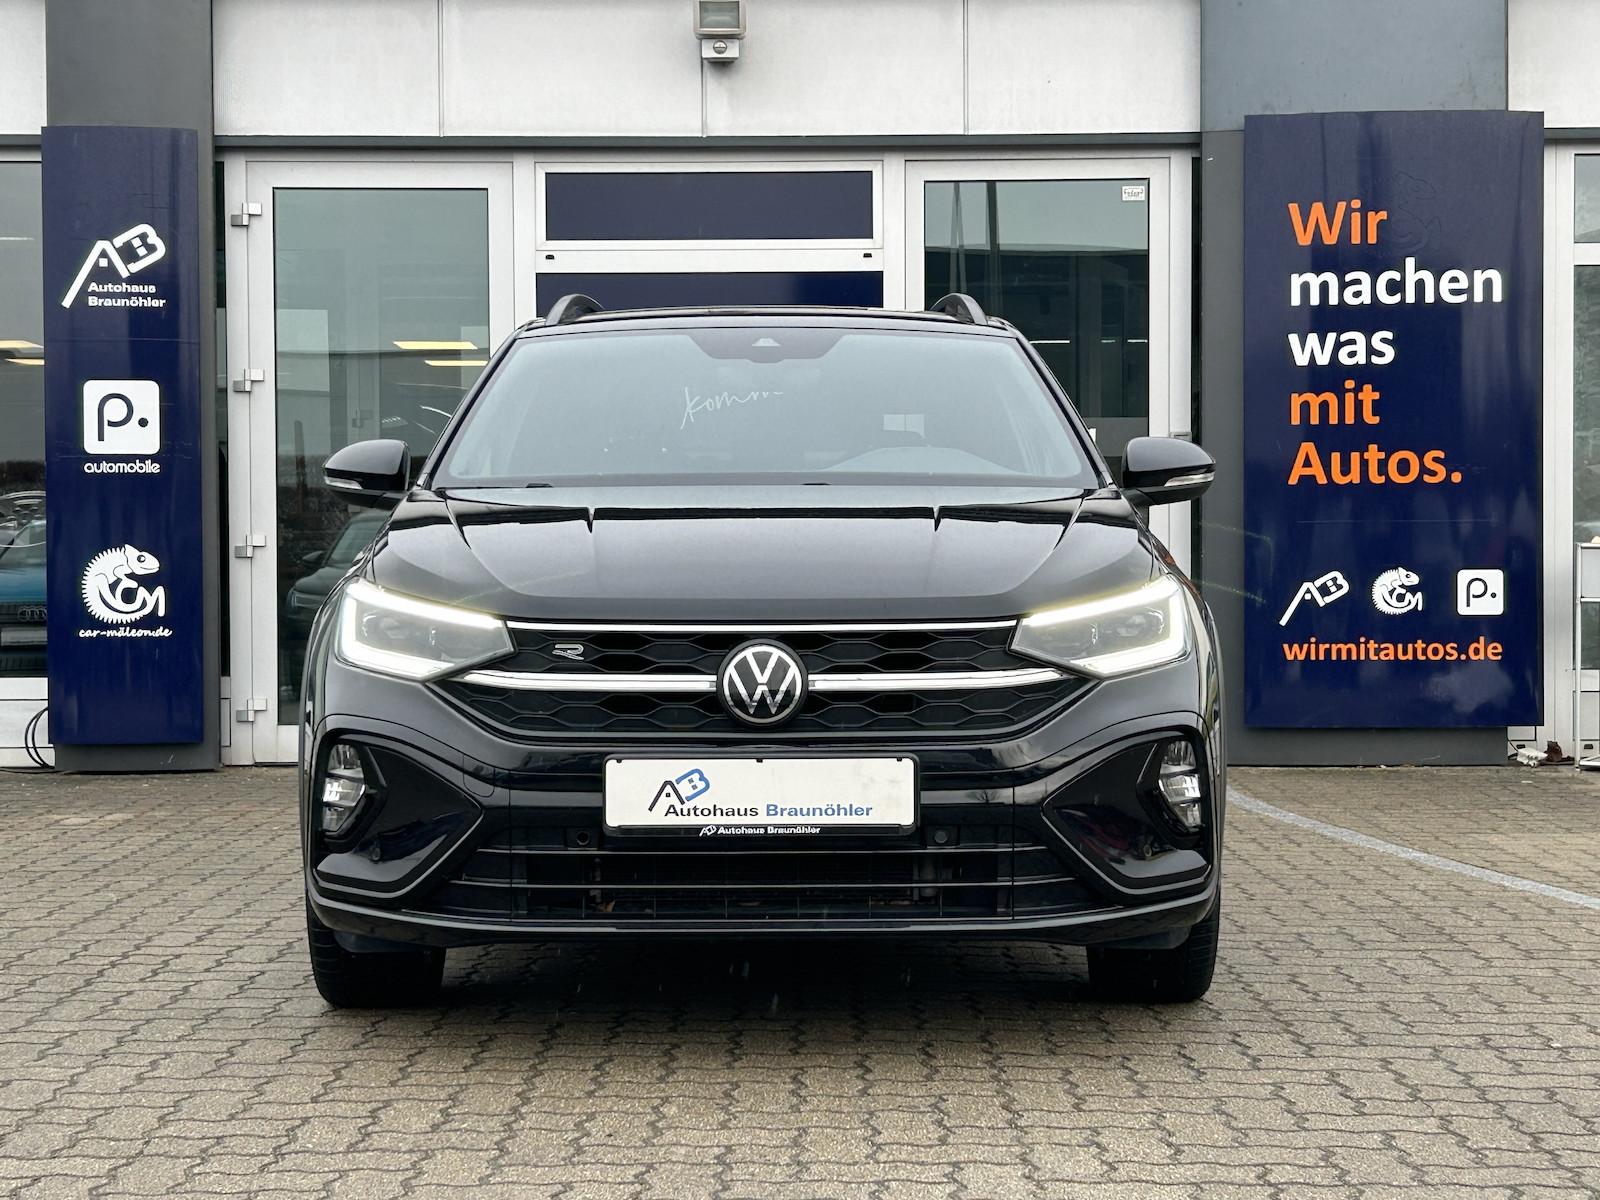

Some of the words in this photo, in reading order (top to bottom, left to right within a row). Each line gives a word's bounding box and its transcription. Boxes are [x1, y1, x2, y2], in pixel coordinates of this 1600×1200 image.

[1288, 199, 1388, 246] Wir
[87, 282, 156, 293] Autohaus
[1290, 256, 1503, 306] machen
[88, 296, 166, 307] Braunöhler
[1288, 330, 1396, 366] was
[1290, 379, 1380, 425] mit
[83, 459, 161, 474] automobile
[1287, 441, 1463, 485] Autos.
[1282, 636, 1503, 661] wirmitautos.de
[664, 804, 759, 817] Autohaus
[766, 803, 873, 817] Braunöhler
[717, 826, 766, 835] Autohaus
